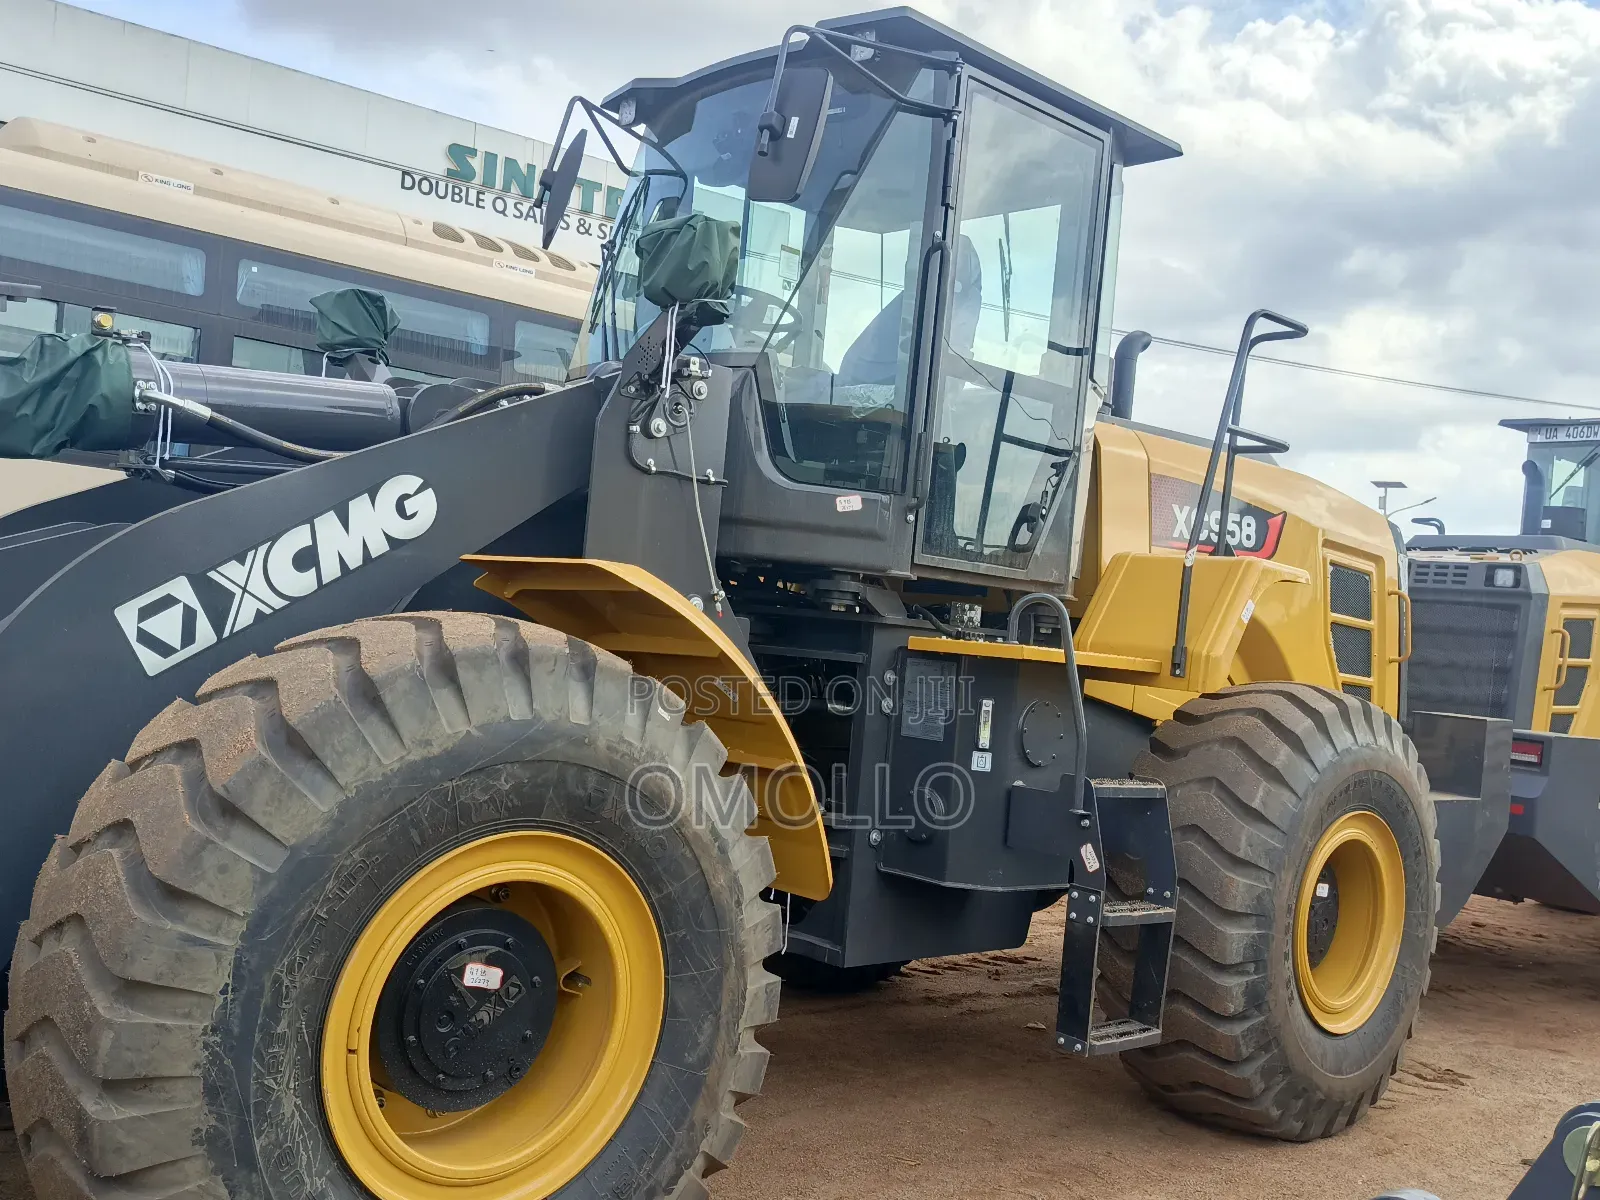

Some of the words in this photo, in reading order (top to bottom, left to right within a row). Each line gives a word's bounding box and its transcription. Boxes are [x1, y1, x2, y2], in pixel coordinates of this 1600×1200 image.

[154, 178, 171, 186] KING
[172, 182, 192, 191] LONG
[400, 171, 486, 210] DOUBLE
[491, 196, 509, 217] Q
[512, 201, 571, 231] SALS
[576, 217, 593, 237] &
[1545, 427, 1558, 440] UA
[206, 473, 439, 639] XCMG
